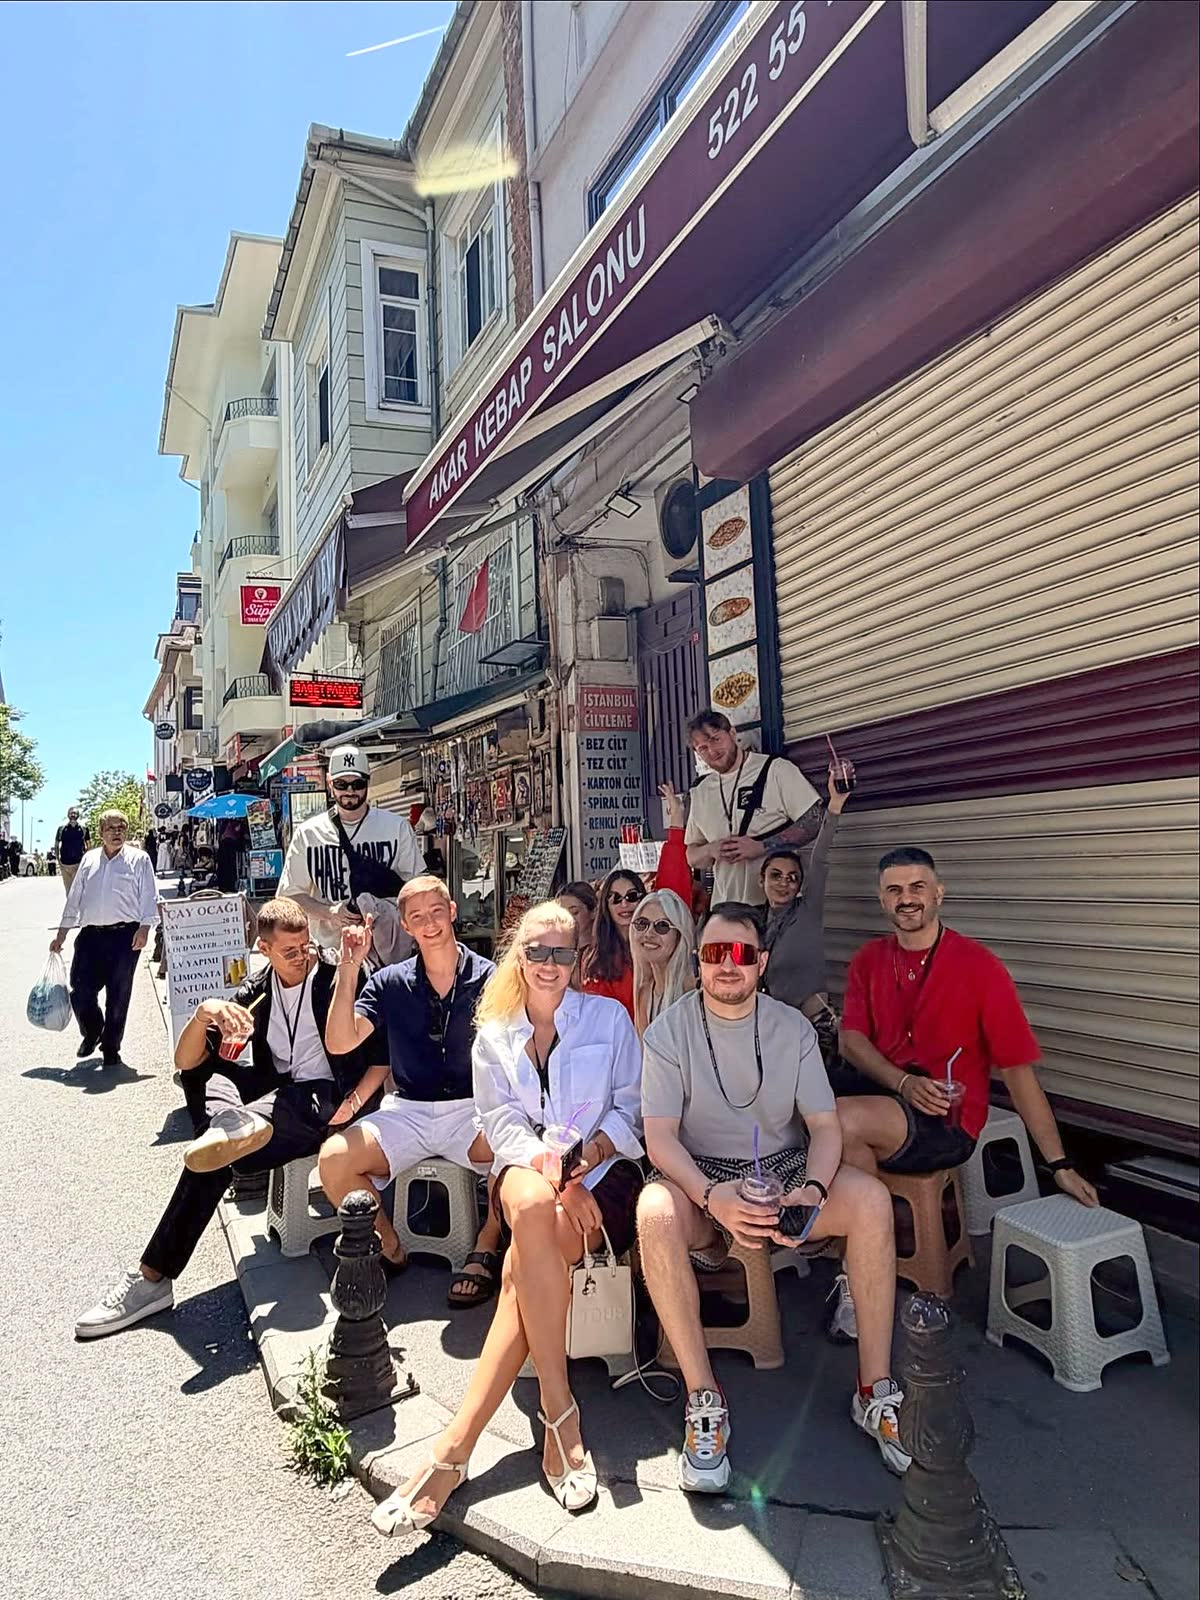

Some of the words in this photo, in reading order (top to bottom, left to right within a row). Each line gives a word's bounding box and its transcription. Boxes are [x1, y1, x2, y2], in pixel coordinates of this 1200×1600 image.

[429, 438, 468, 509] AKAR
[474, 355, 533, 458] KEBAP
[543, 203, 646, 373] SALONU
[708, 62, 759, 160] 522
[768, 0, 806, 81] 55
[583, 689, 635, 707] İSTANBUL
[584, 711, 633, 728] CİLTLEME
[586, 738, 605, 750] BEZ
[608, 734, 627, 750] CİLT
[586, 757, 605, 770] TEZ
[607, 753, 627, 770] CİLT
[587, 777, 622, 790] KARTON
[623, 773, 640, 789] CİLT
[588, 793, 620, 809] SPİRAL
[621, 792, 640, 809] CİLT
[589, 813, 618, 830] RENKLİ
[589, 837, 605, 850] S/B
[167, 908, 193, 921] ÇAY
[197, 901, 238, 916] OCAĞI
